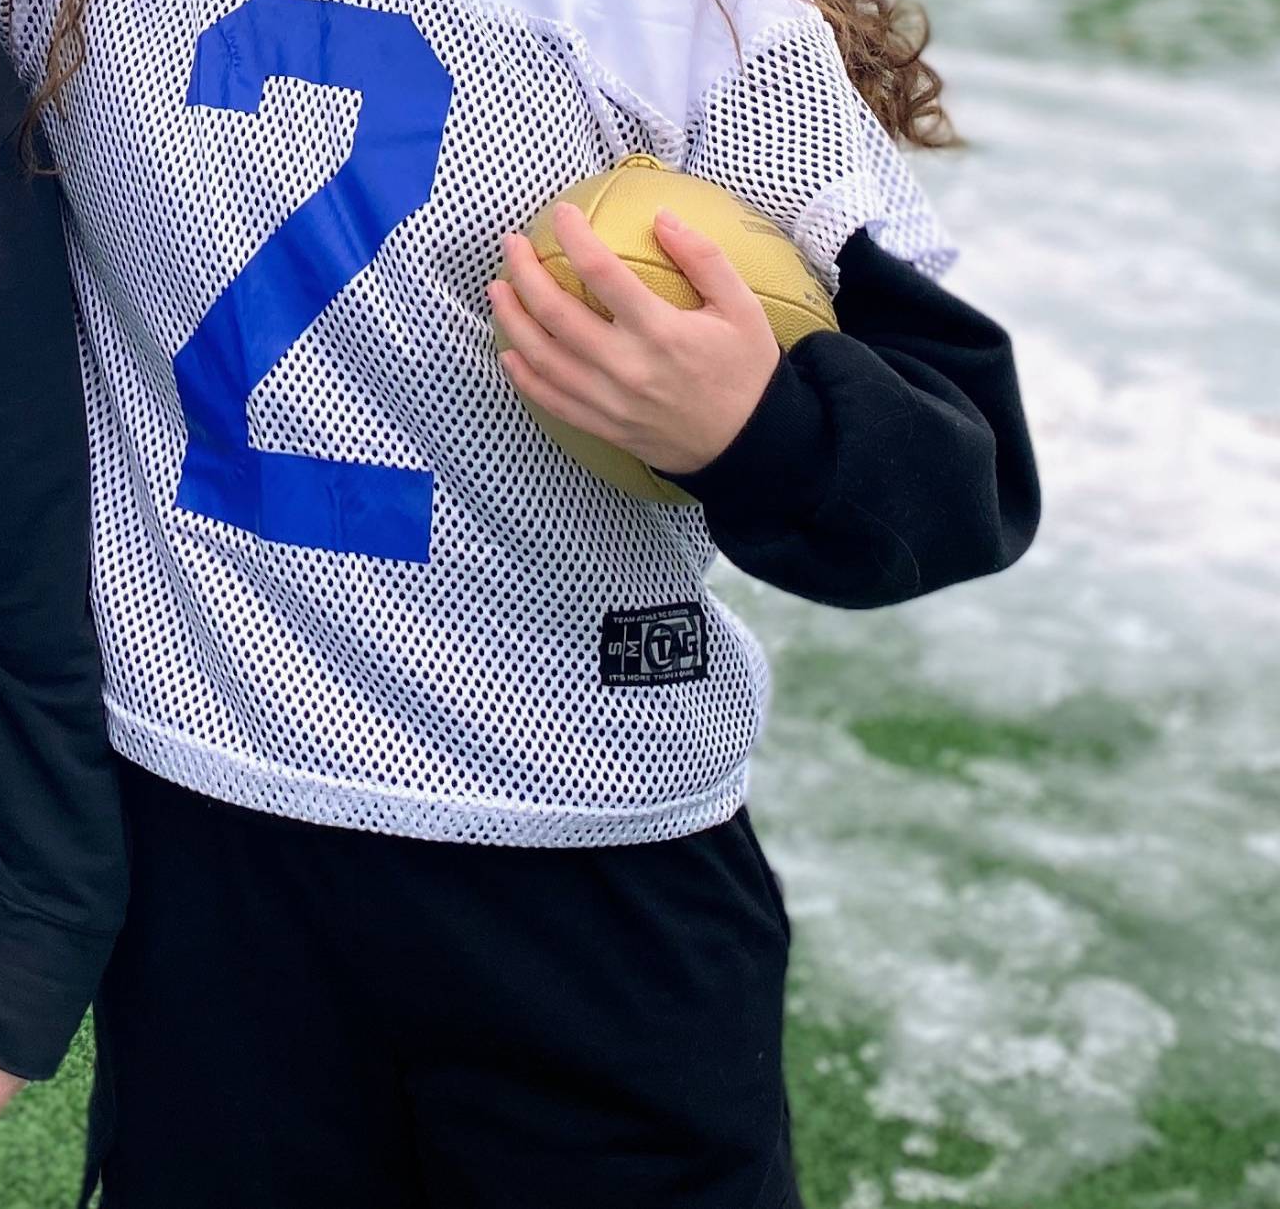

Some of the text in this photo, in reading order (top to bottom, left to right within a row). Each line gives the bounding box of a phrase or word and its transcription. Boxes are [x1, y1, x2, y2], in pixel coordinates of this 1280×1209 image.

[613, 616, 635, 624] TEAM
[608, 642, 623, 656] S
[625, 640, 641, 658] M
[609, 674, 625, 682] IT'S
[627, 674, 650, 682] MORE
[653, 671, 673, 680] THAN
